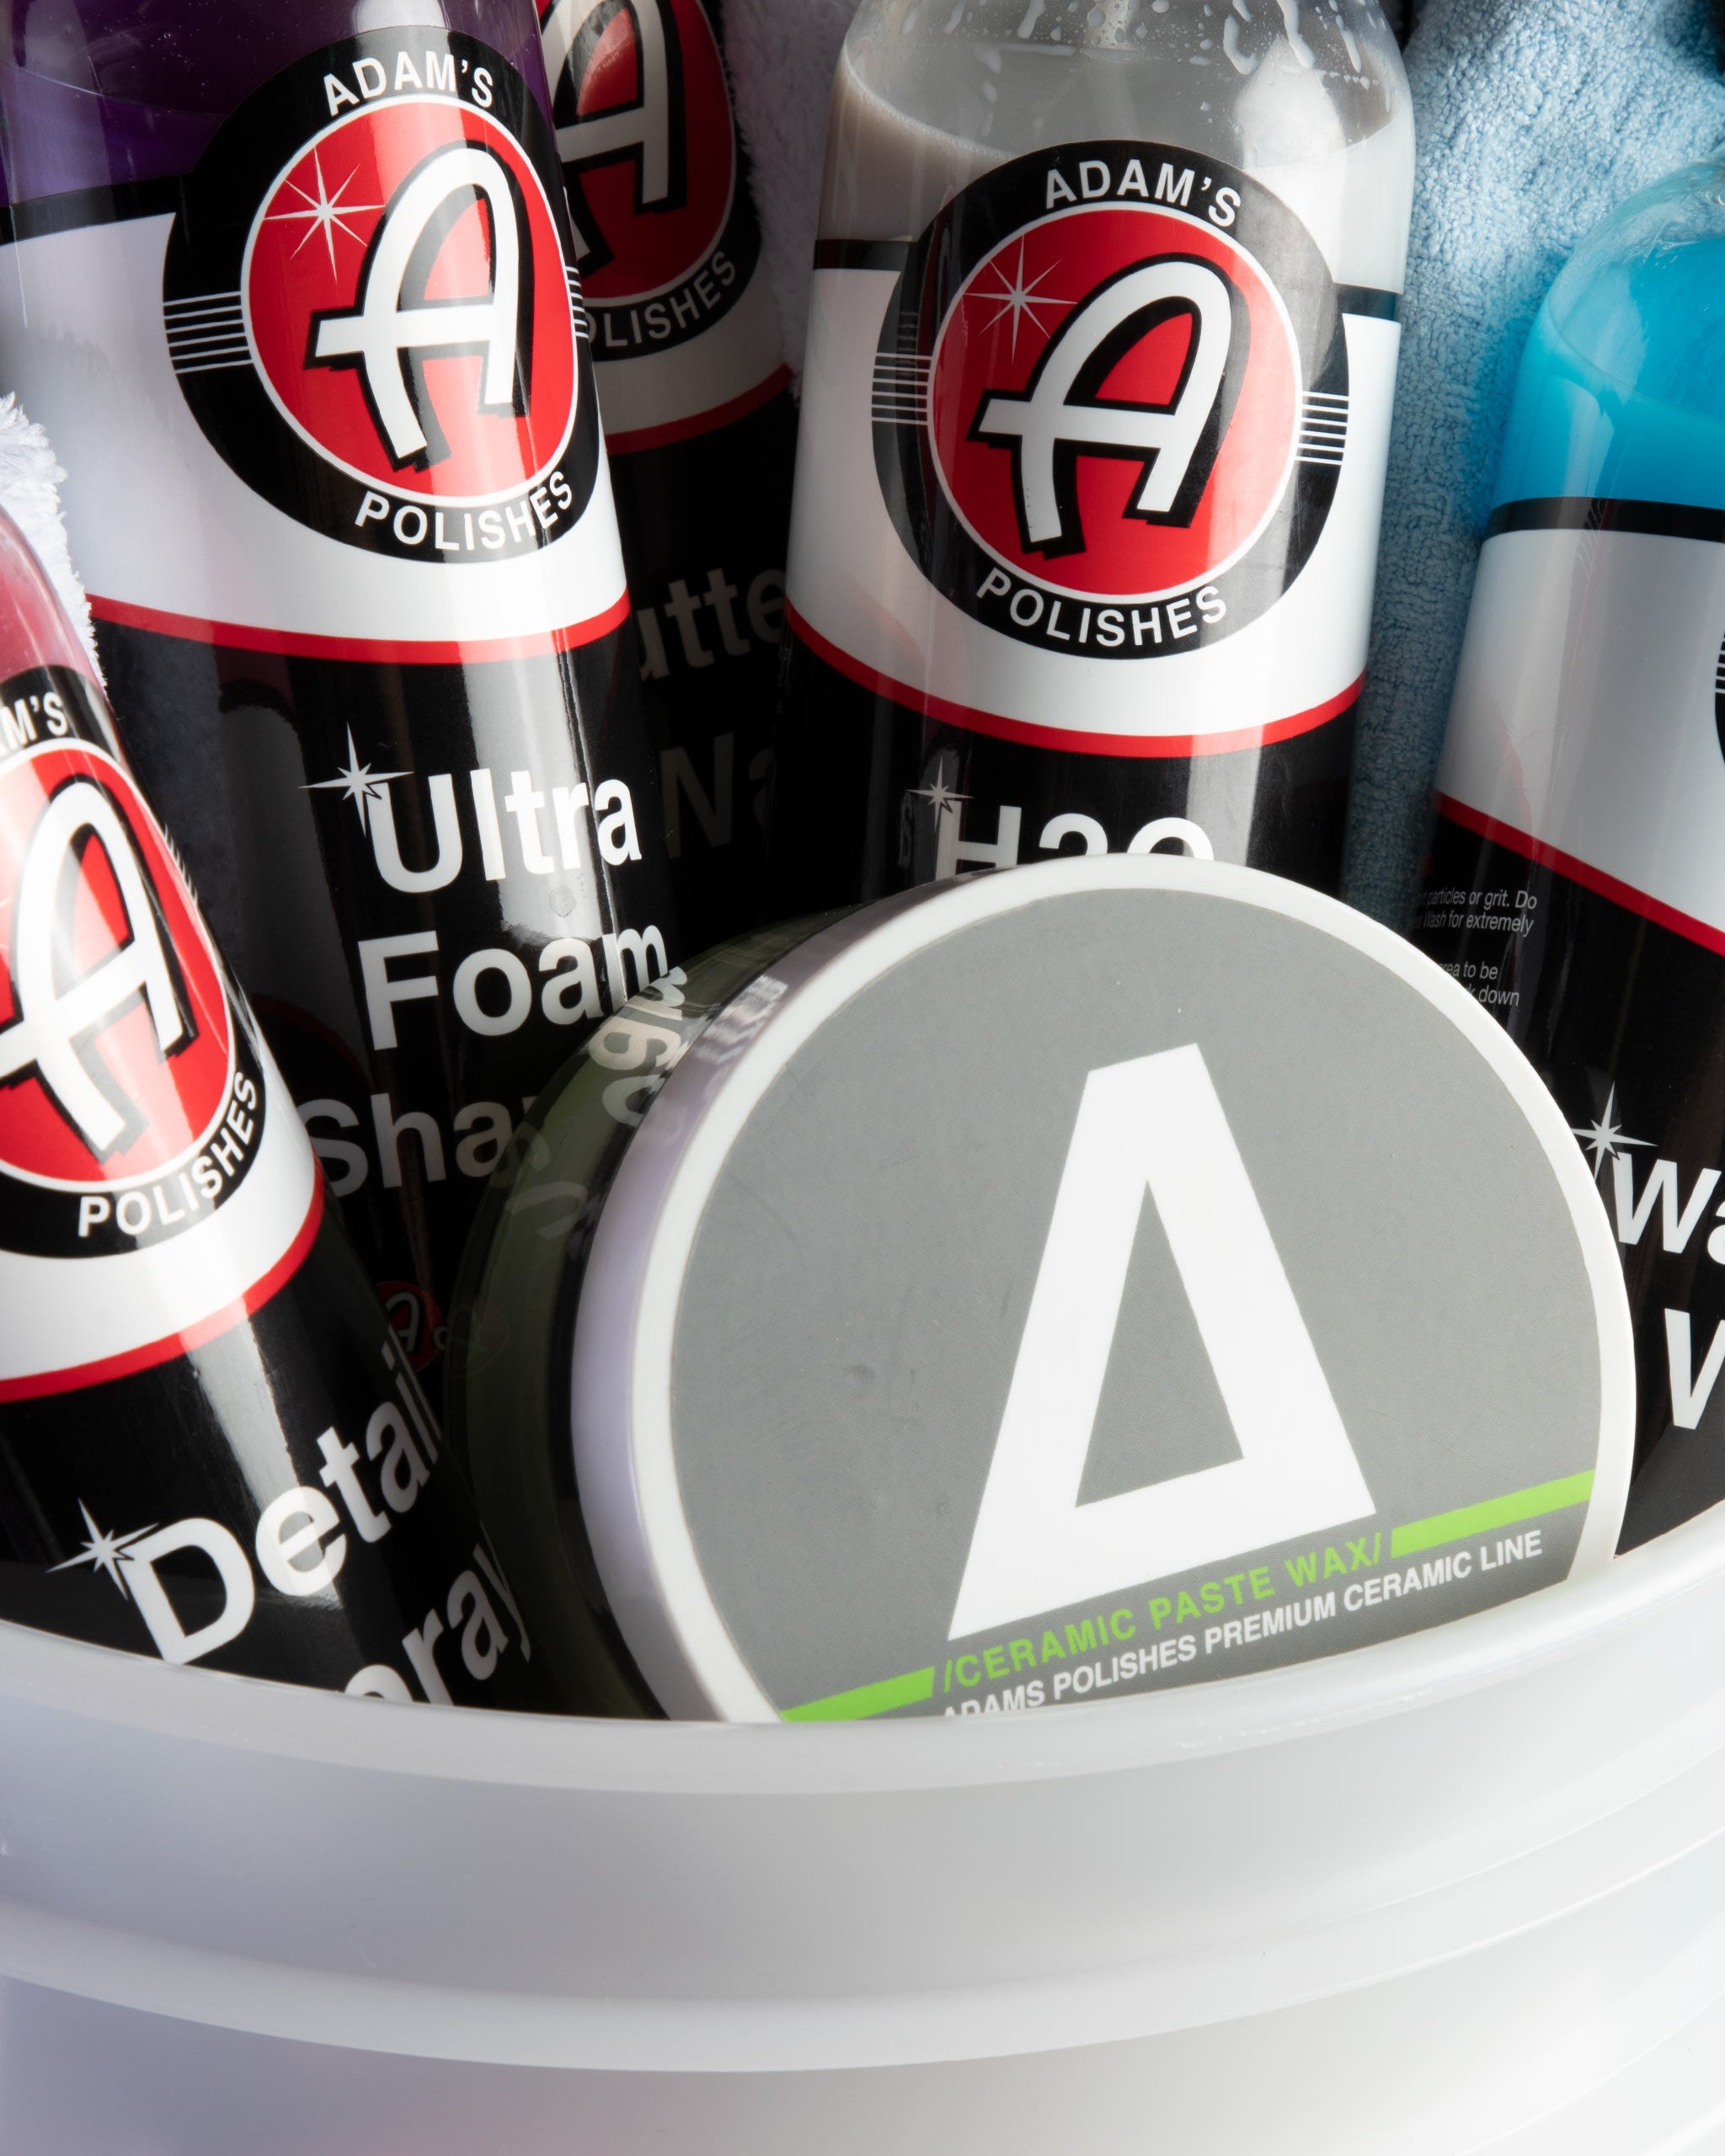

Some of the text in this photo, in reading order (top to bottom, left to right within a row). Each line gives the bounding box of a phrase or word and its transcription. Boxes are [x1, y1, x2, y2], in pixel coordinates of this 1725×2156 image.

[323, 50, 494, 116] ADAM'S
[1044, 158, 1242, 228] ADAM'S
[314, 147, 520, 461] A
[978, 261, 1231, 544] A
[355, 470, 574, 551] POLISHES
[975, 567, 1226, 647] POLISHES
[363, 767, 643, 894] Ultra
[1448, 909, 1465, 928] for
[1466, 912, 1535, 938] extremely
[1468, 891, 1483, 905] or
[1483, 889, 1510, 910] grit.
[1514, 889, 1537, 910] Do
[357, 924, 669, 1051] Foam
[1463, 960, 1477, 978] to
[1478, 961, 1498, 980] be
[1478, 985, 1520, 1006] down
[78, 1071, 257, 1236] POLISHES
[297, 1091, 537, 1198] Sha
[119, 1325, 442, 1666] Detail
[1053, 1634, 1197, 1700] POLISHES
[1204, 1591, 1337, 1655] PREMIUM
[1343, 1550, 1472, 1612] CERAMIC
[1479, 1529, 1543, 1572] LINE
[1147, 1565, 1276, 1630] PASTE
